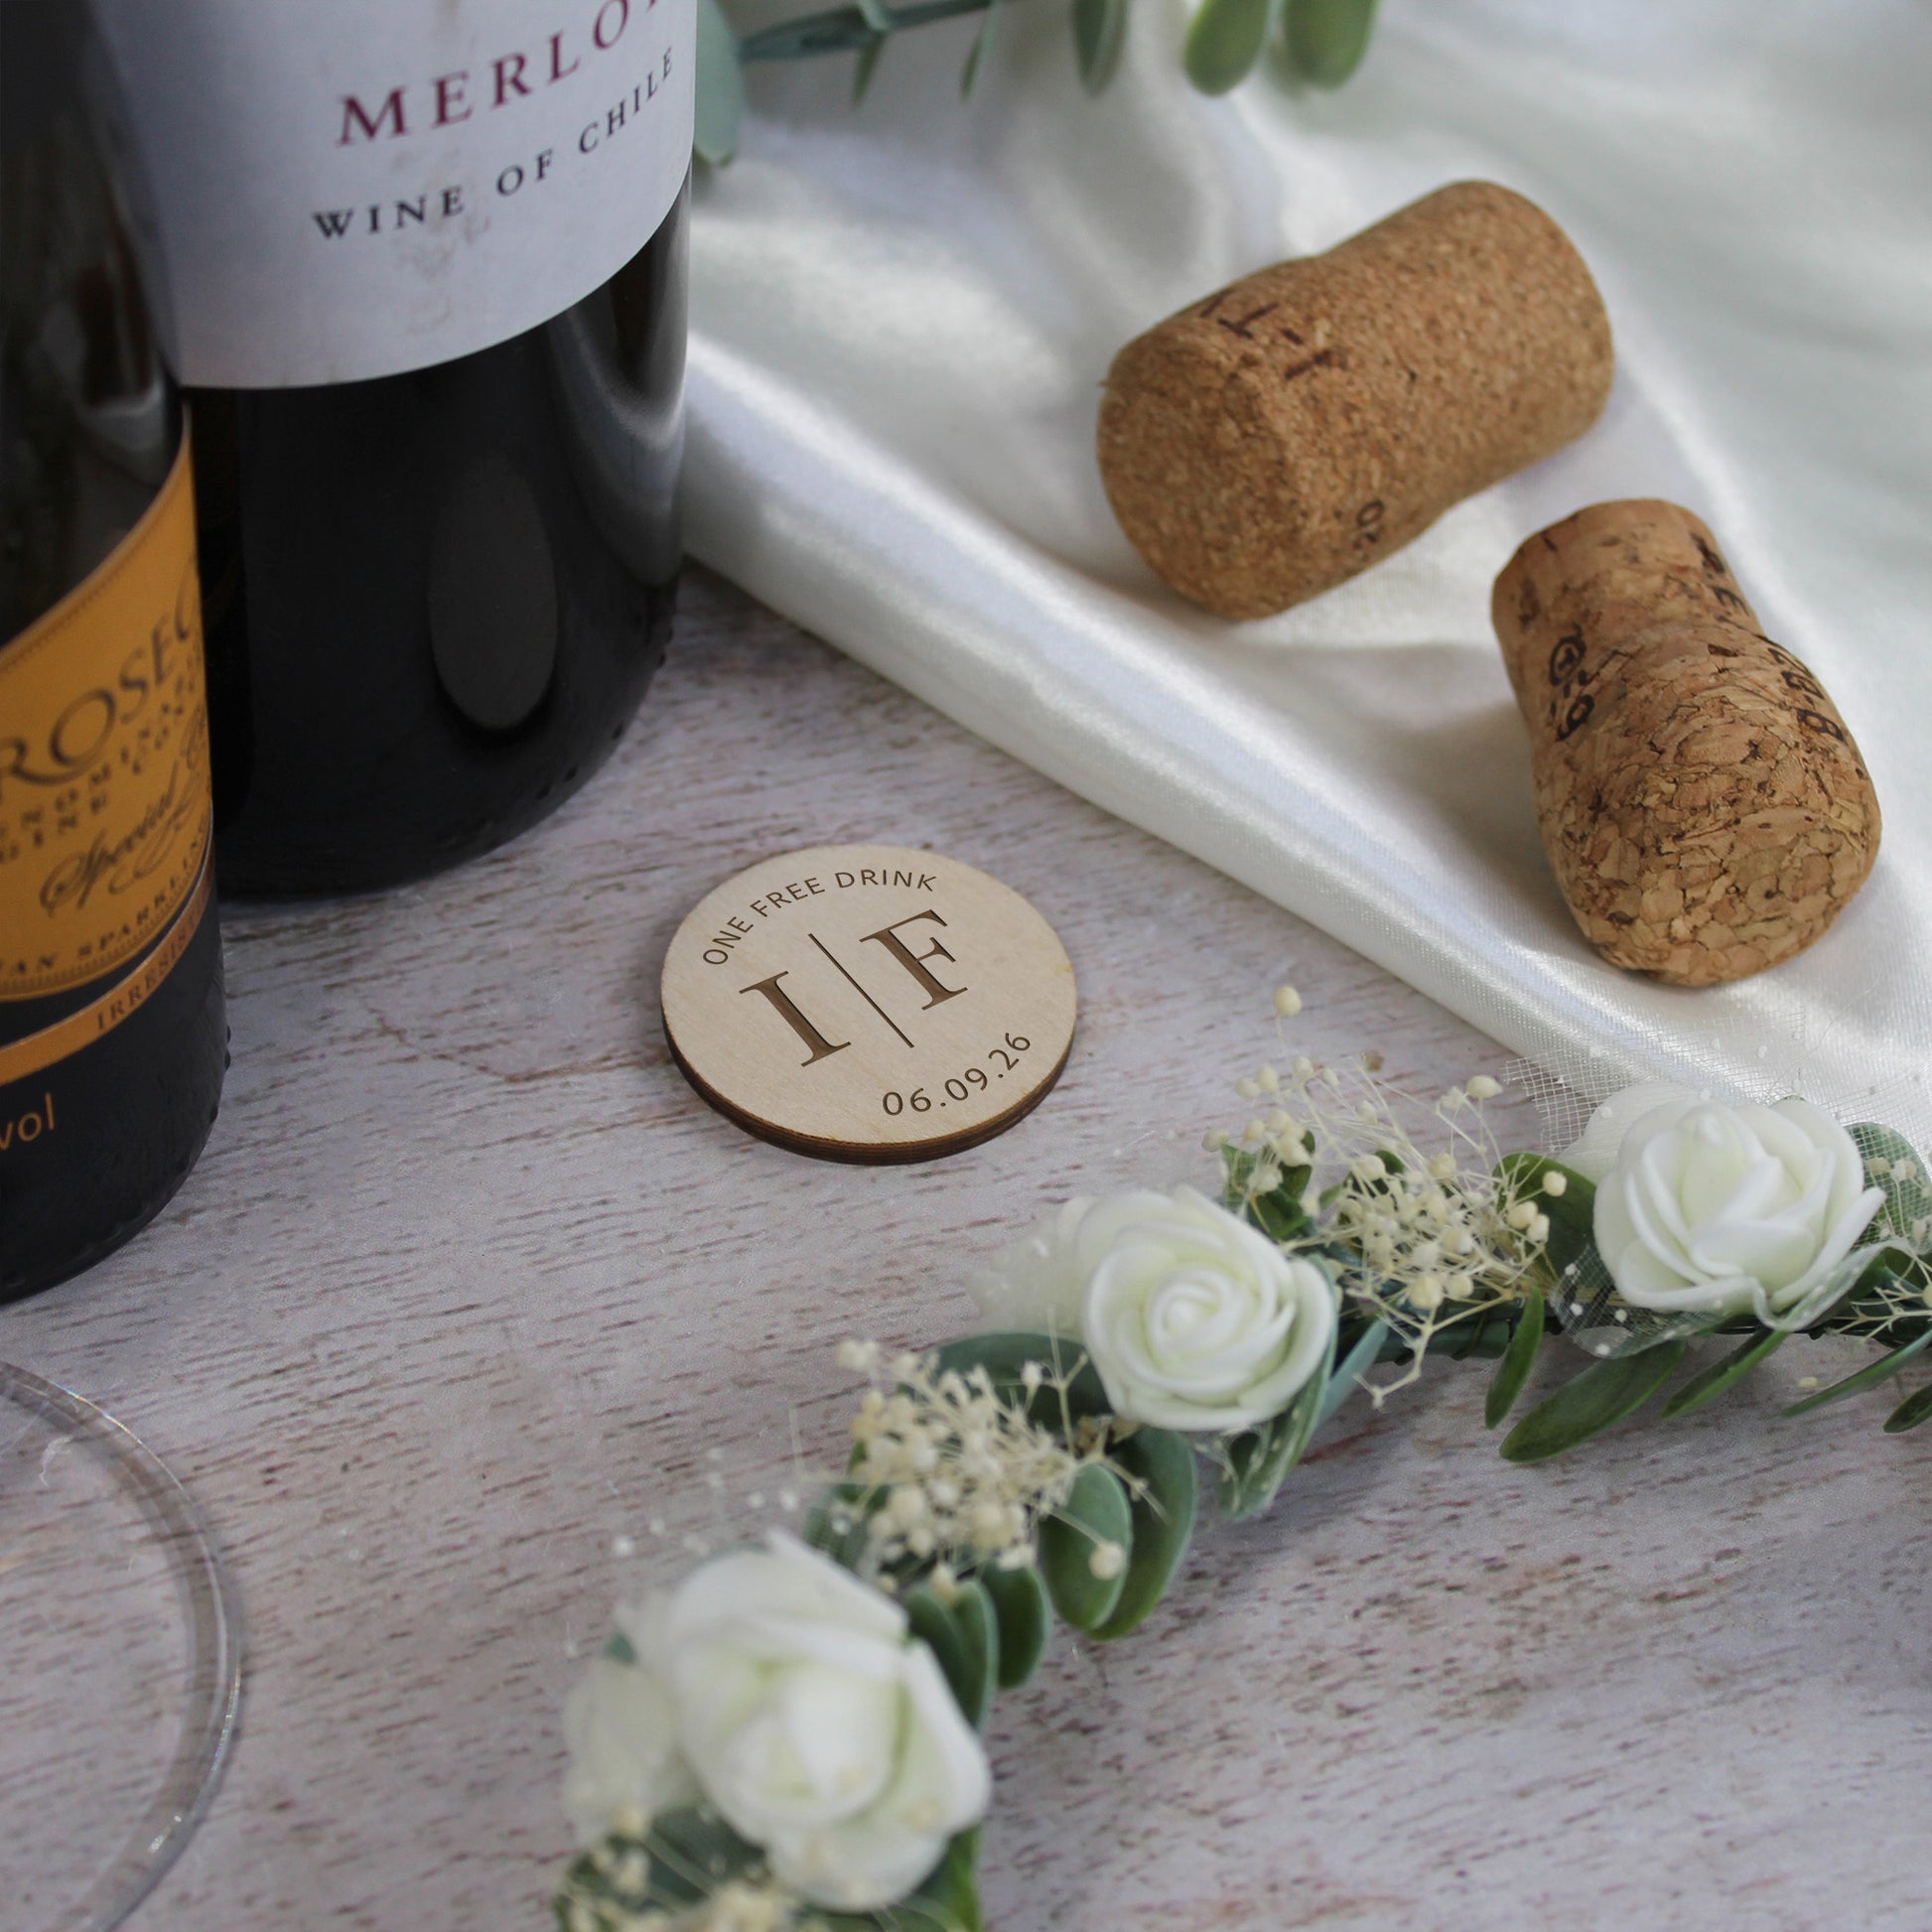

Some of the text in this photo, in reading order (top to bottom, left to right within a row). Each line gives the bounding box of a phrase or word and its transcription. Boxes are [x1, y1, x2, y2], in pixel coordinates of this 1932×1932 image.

[335, 0, 656, 147] MERLO
[312, 46, 673, 240] WINE OF CHILE
[703, 869, 938, 966] ONE FREE DRINK
[859, 908, 969, 1012] F
[882, 1032, 1032, 1117] 06.09.26
